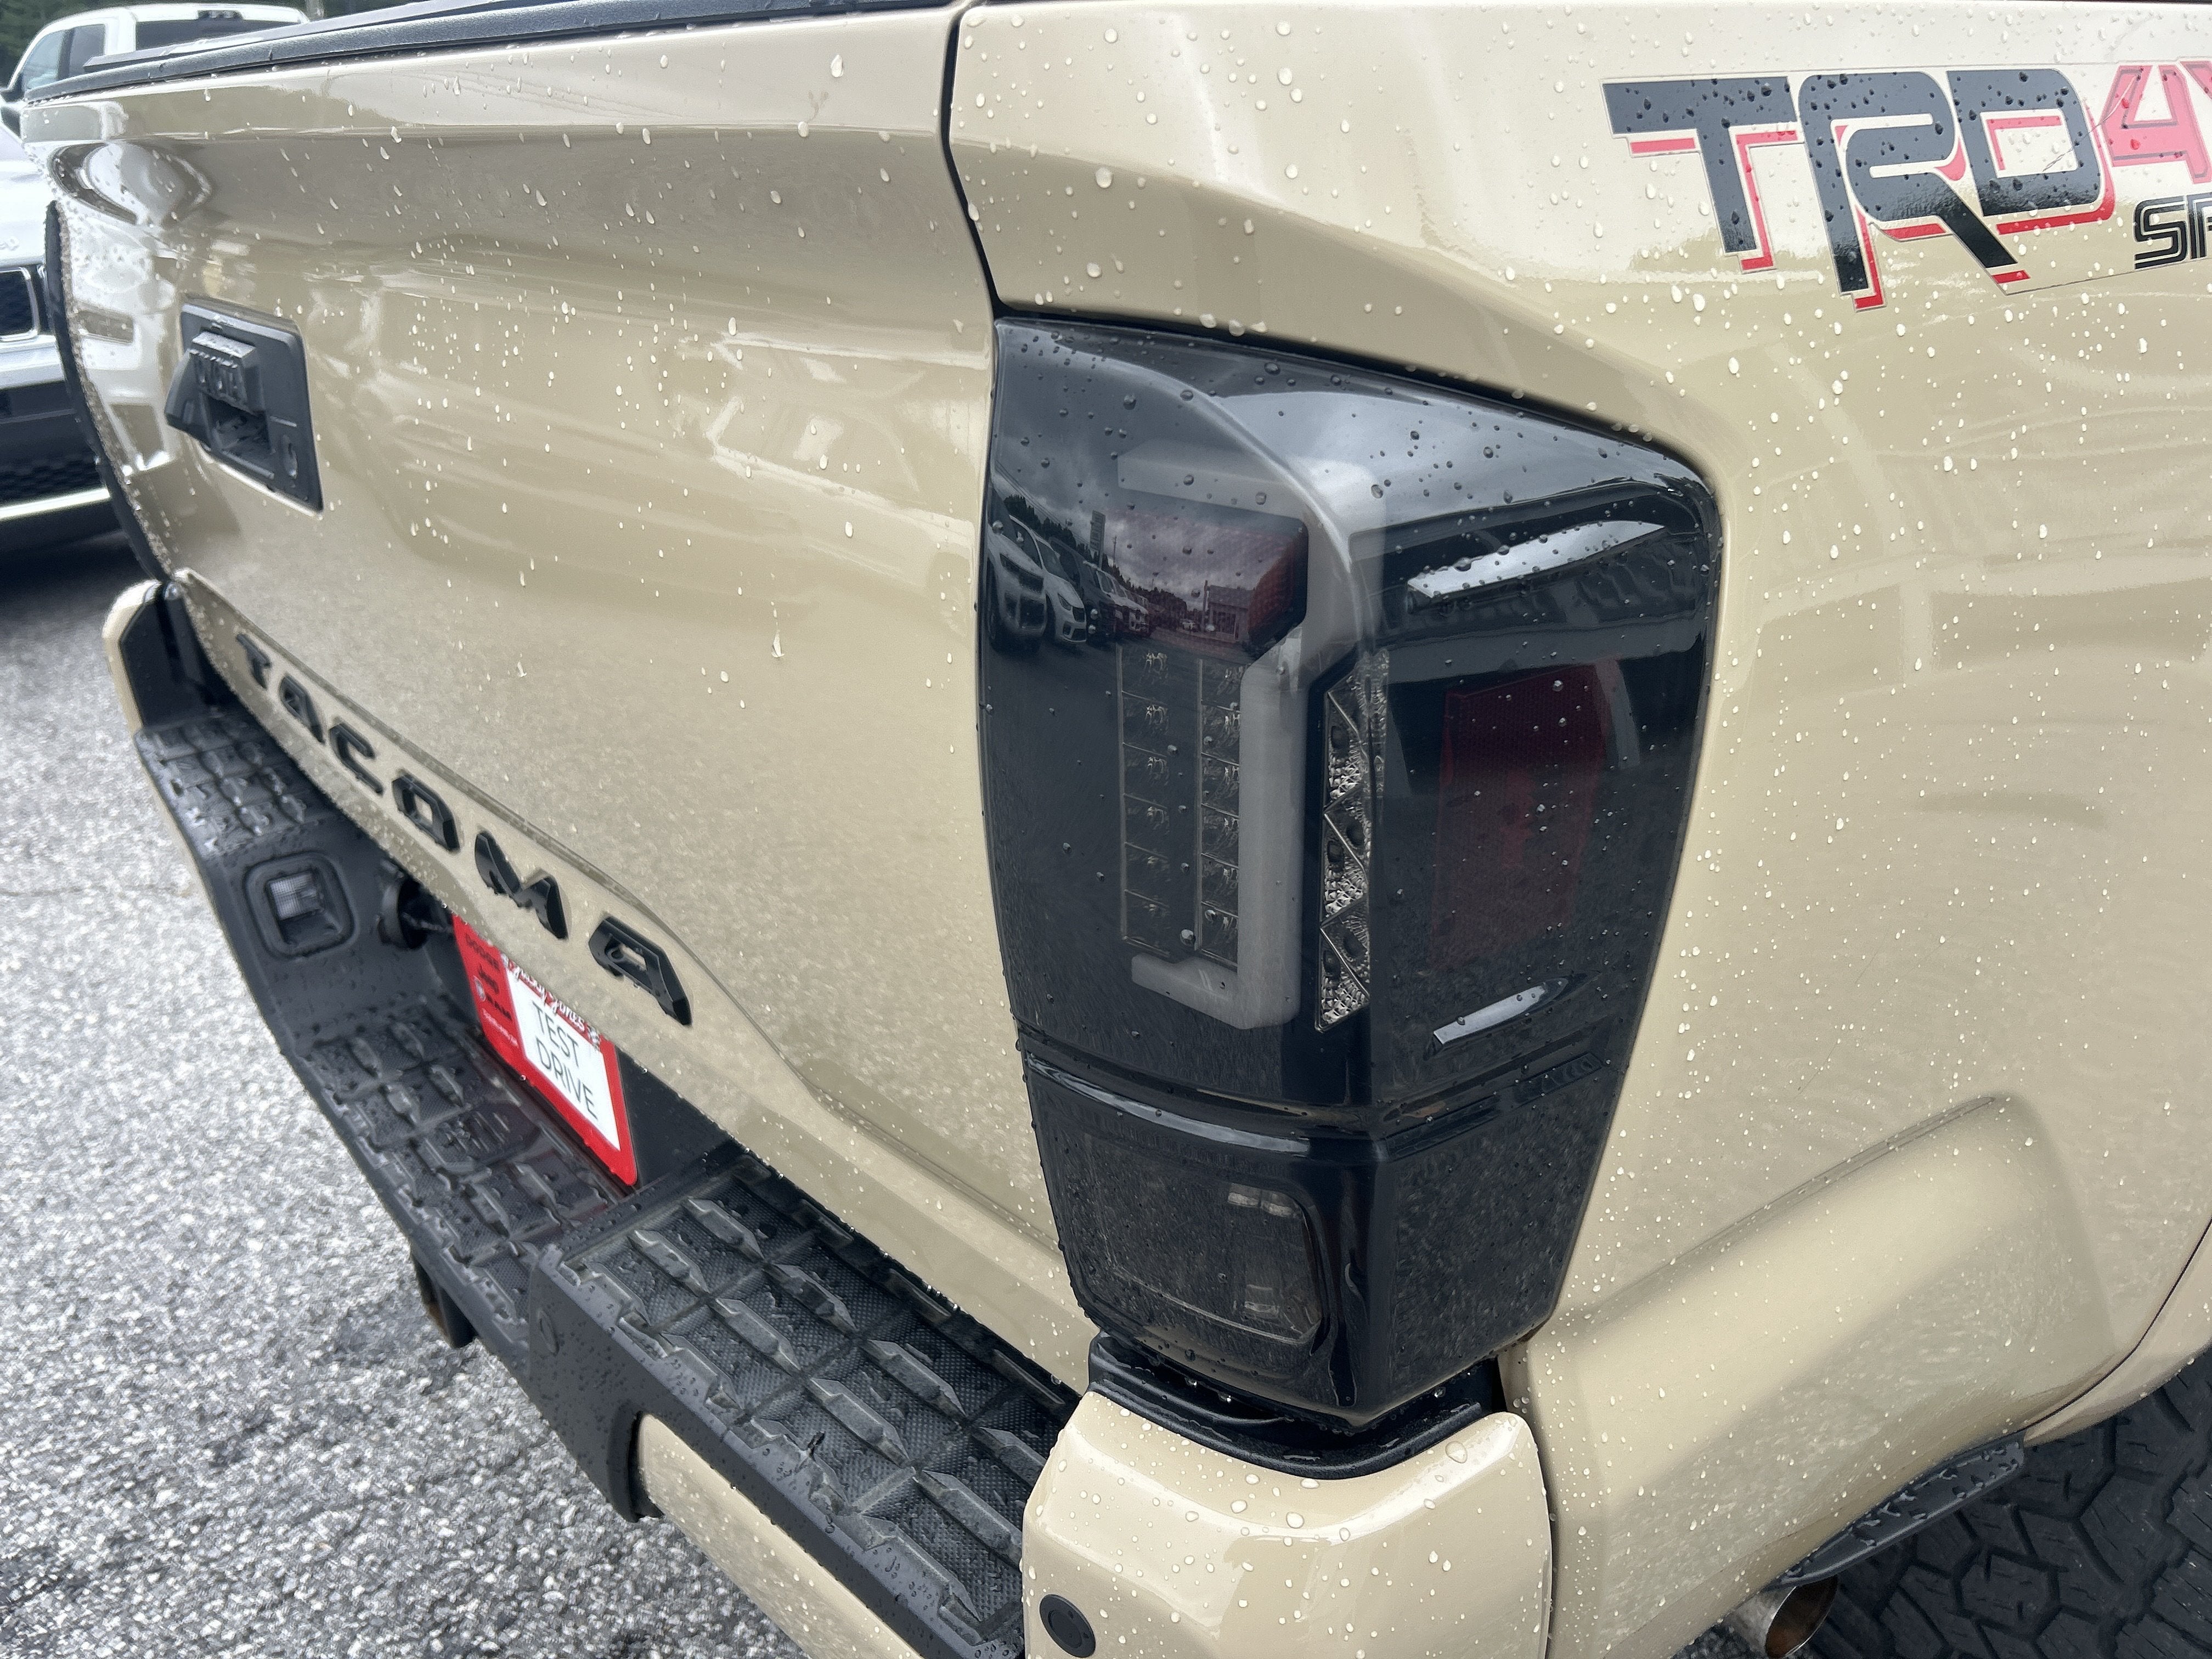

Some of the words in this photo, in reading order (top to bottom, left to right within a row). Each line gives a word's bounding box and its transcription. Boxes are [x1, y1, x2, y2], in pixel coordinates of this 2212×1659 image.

[1601, 67, 2116, 312] TRD
[236, 633, 693, 1028] TACOMA
[532, 1000, 579, 1068] TEST
[535, 1035, 599, 1121] DRIVE
